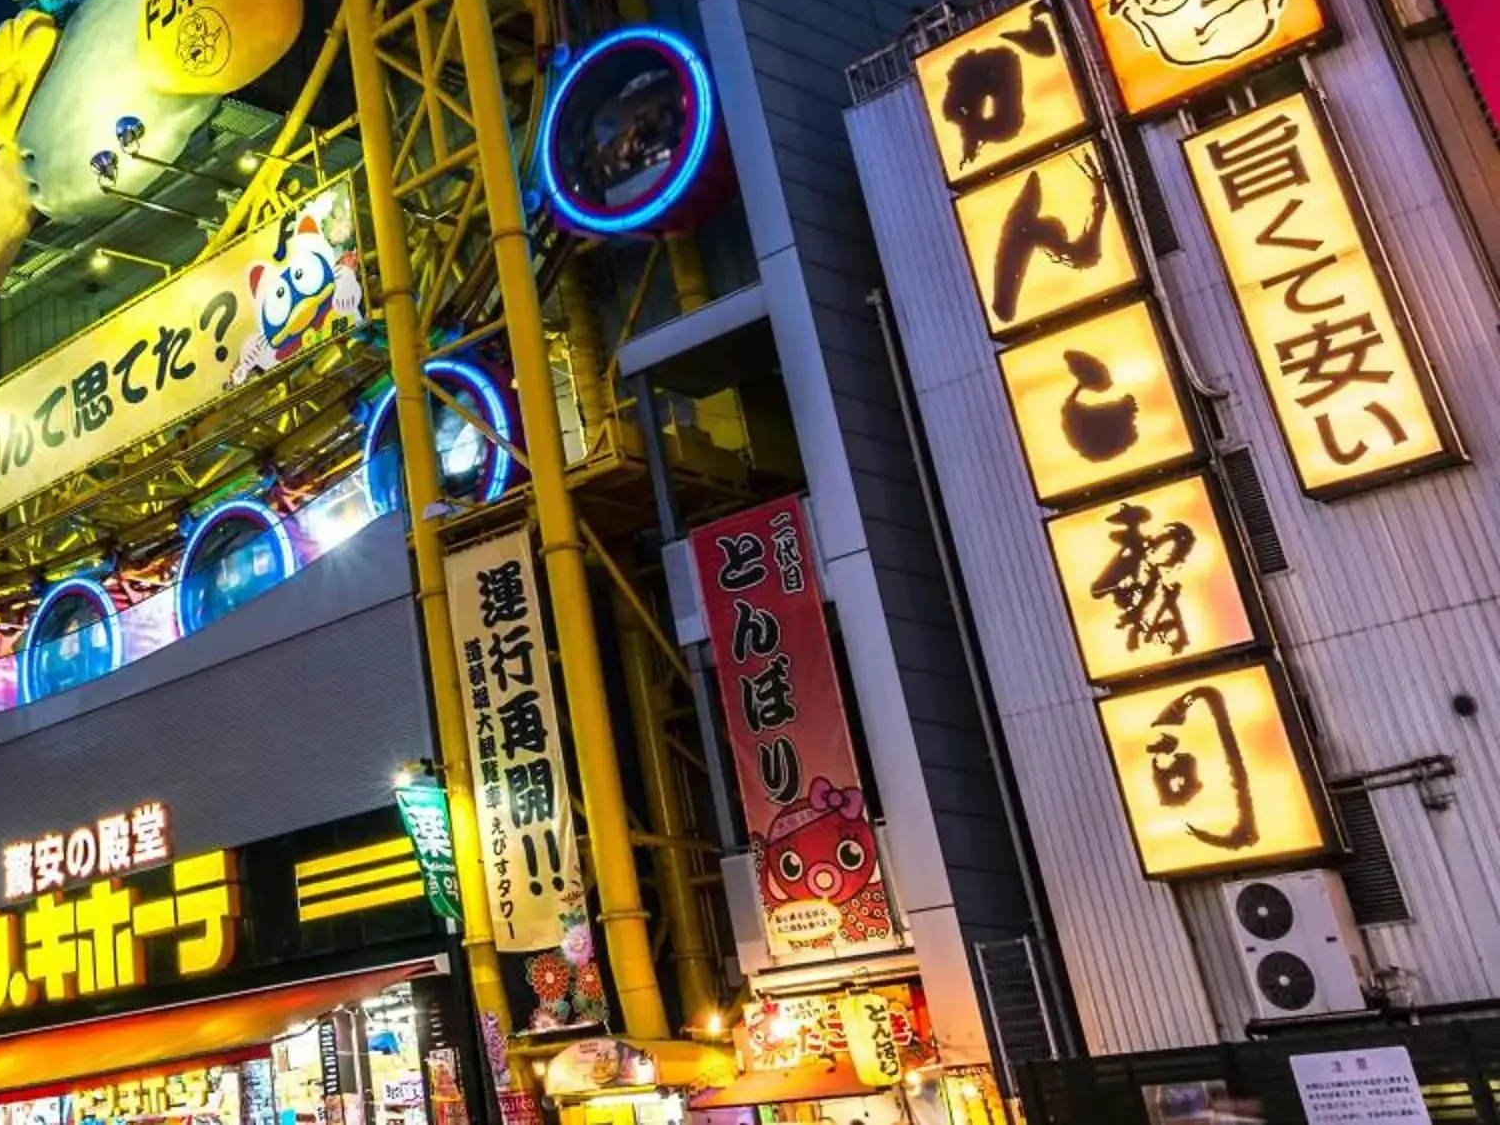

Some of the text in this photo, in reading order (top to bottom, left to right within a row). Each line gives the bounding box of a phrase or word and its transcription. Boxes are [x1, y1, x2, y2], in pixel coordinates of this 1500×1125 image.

[1205, 113, 1408, 465] 旨くて安い
[716, 532, 801, 807] とんぼり
[770, 512, 804, 593] 二代目
